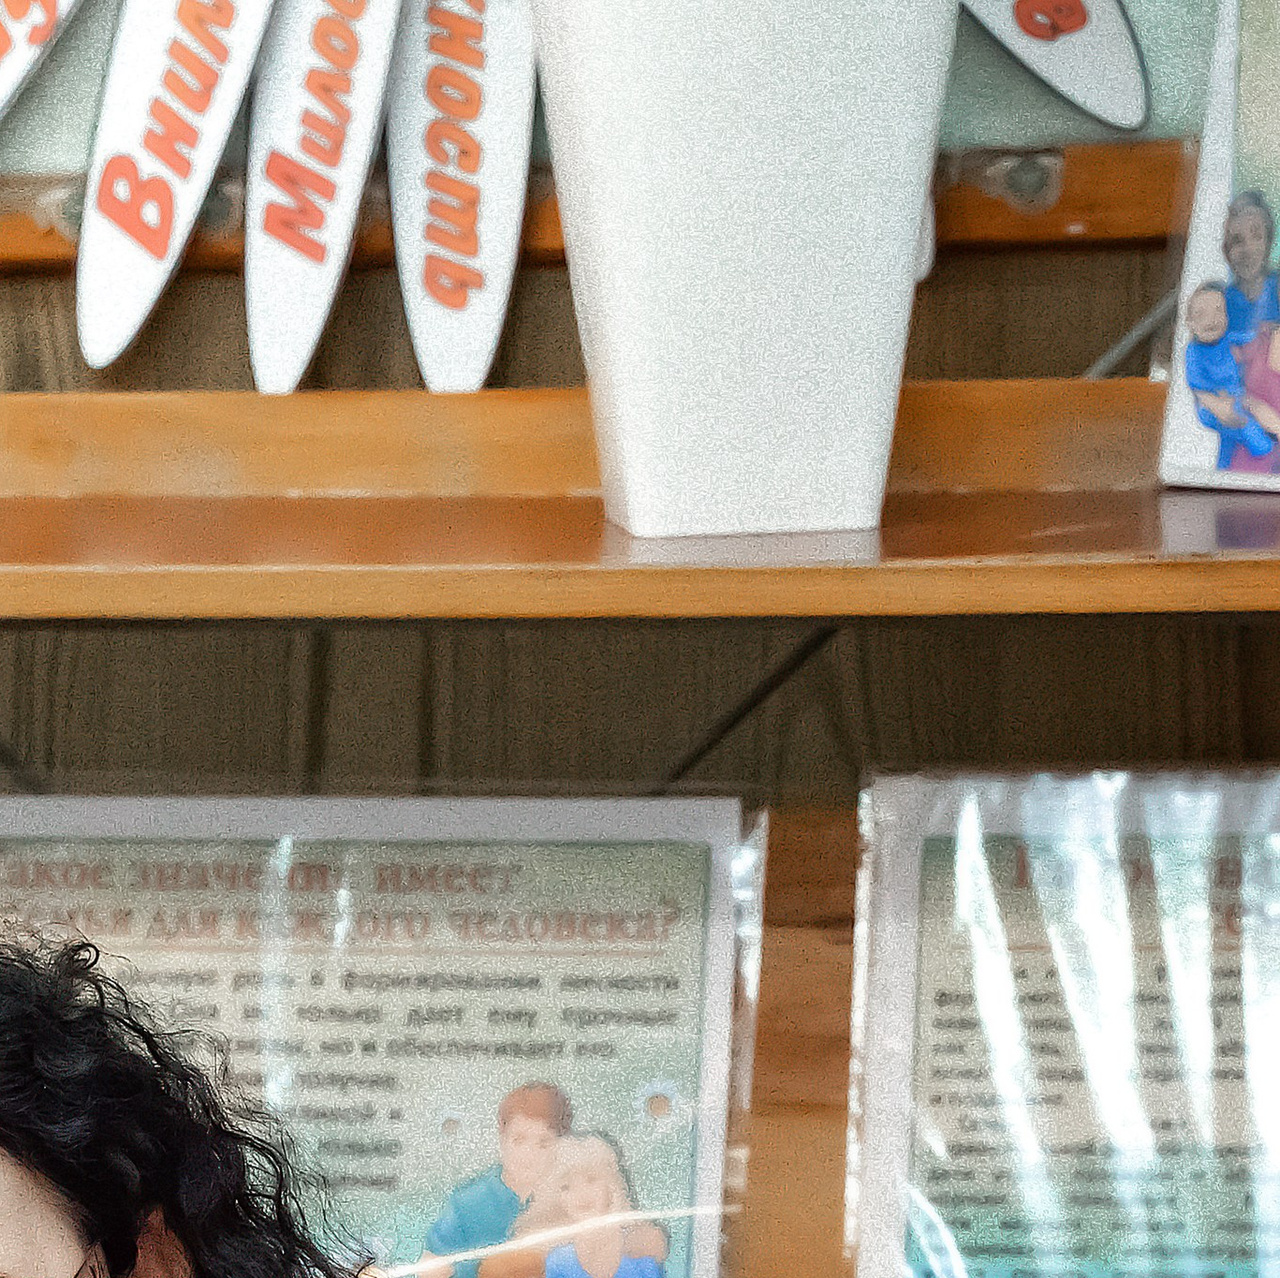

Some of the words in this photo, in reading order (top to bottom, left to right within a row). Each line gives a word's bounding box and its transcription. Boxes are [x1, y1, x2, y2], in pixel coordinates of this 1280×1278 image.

[263, 0, 368, 264] Мило
[423, 0, 486, 311] ность
[131, 860, 346, 891] значеие
[236, 908, 432, 941] кжого
